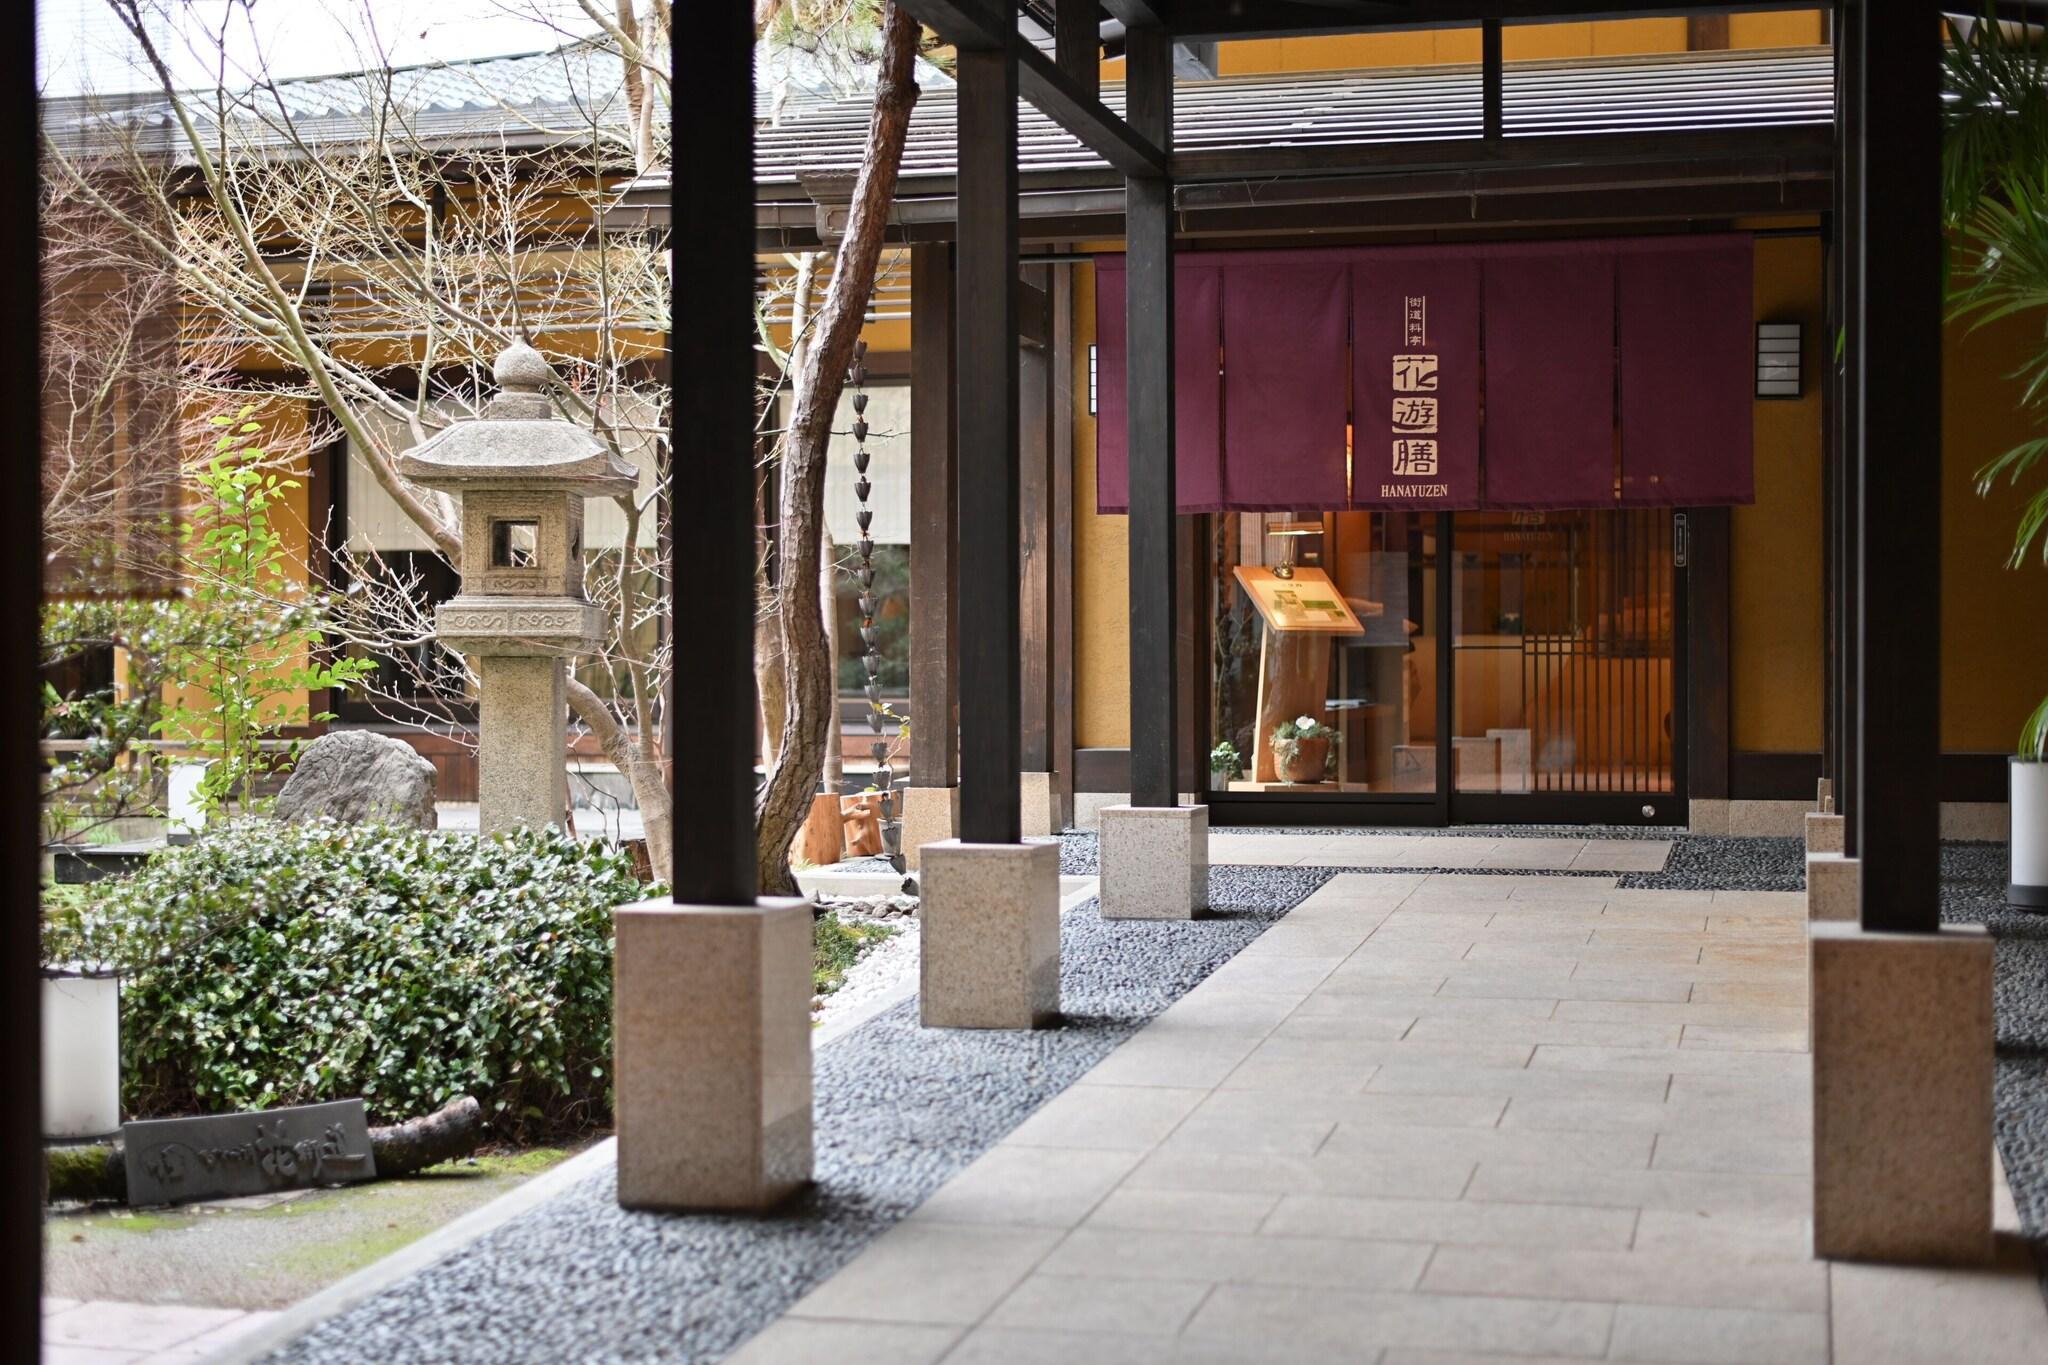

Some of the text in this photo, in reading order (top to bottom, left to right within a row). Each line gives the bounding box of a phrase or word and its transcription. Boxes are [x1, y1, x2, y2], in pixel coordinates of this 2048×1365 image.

[1409, 297, 1422, 346] 街道料亭
[1393, 355, 1438, 476] 花遊膳
[1381, 484, 1448, 497] HANAYUZEN
